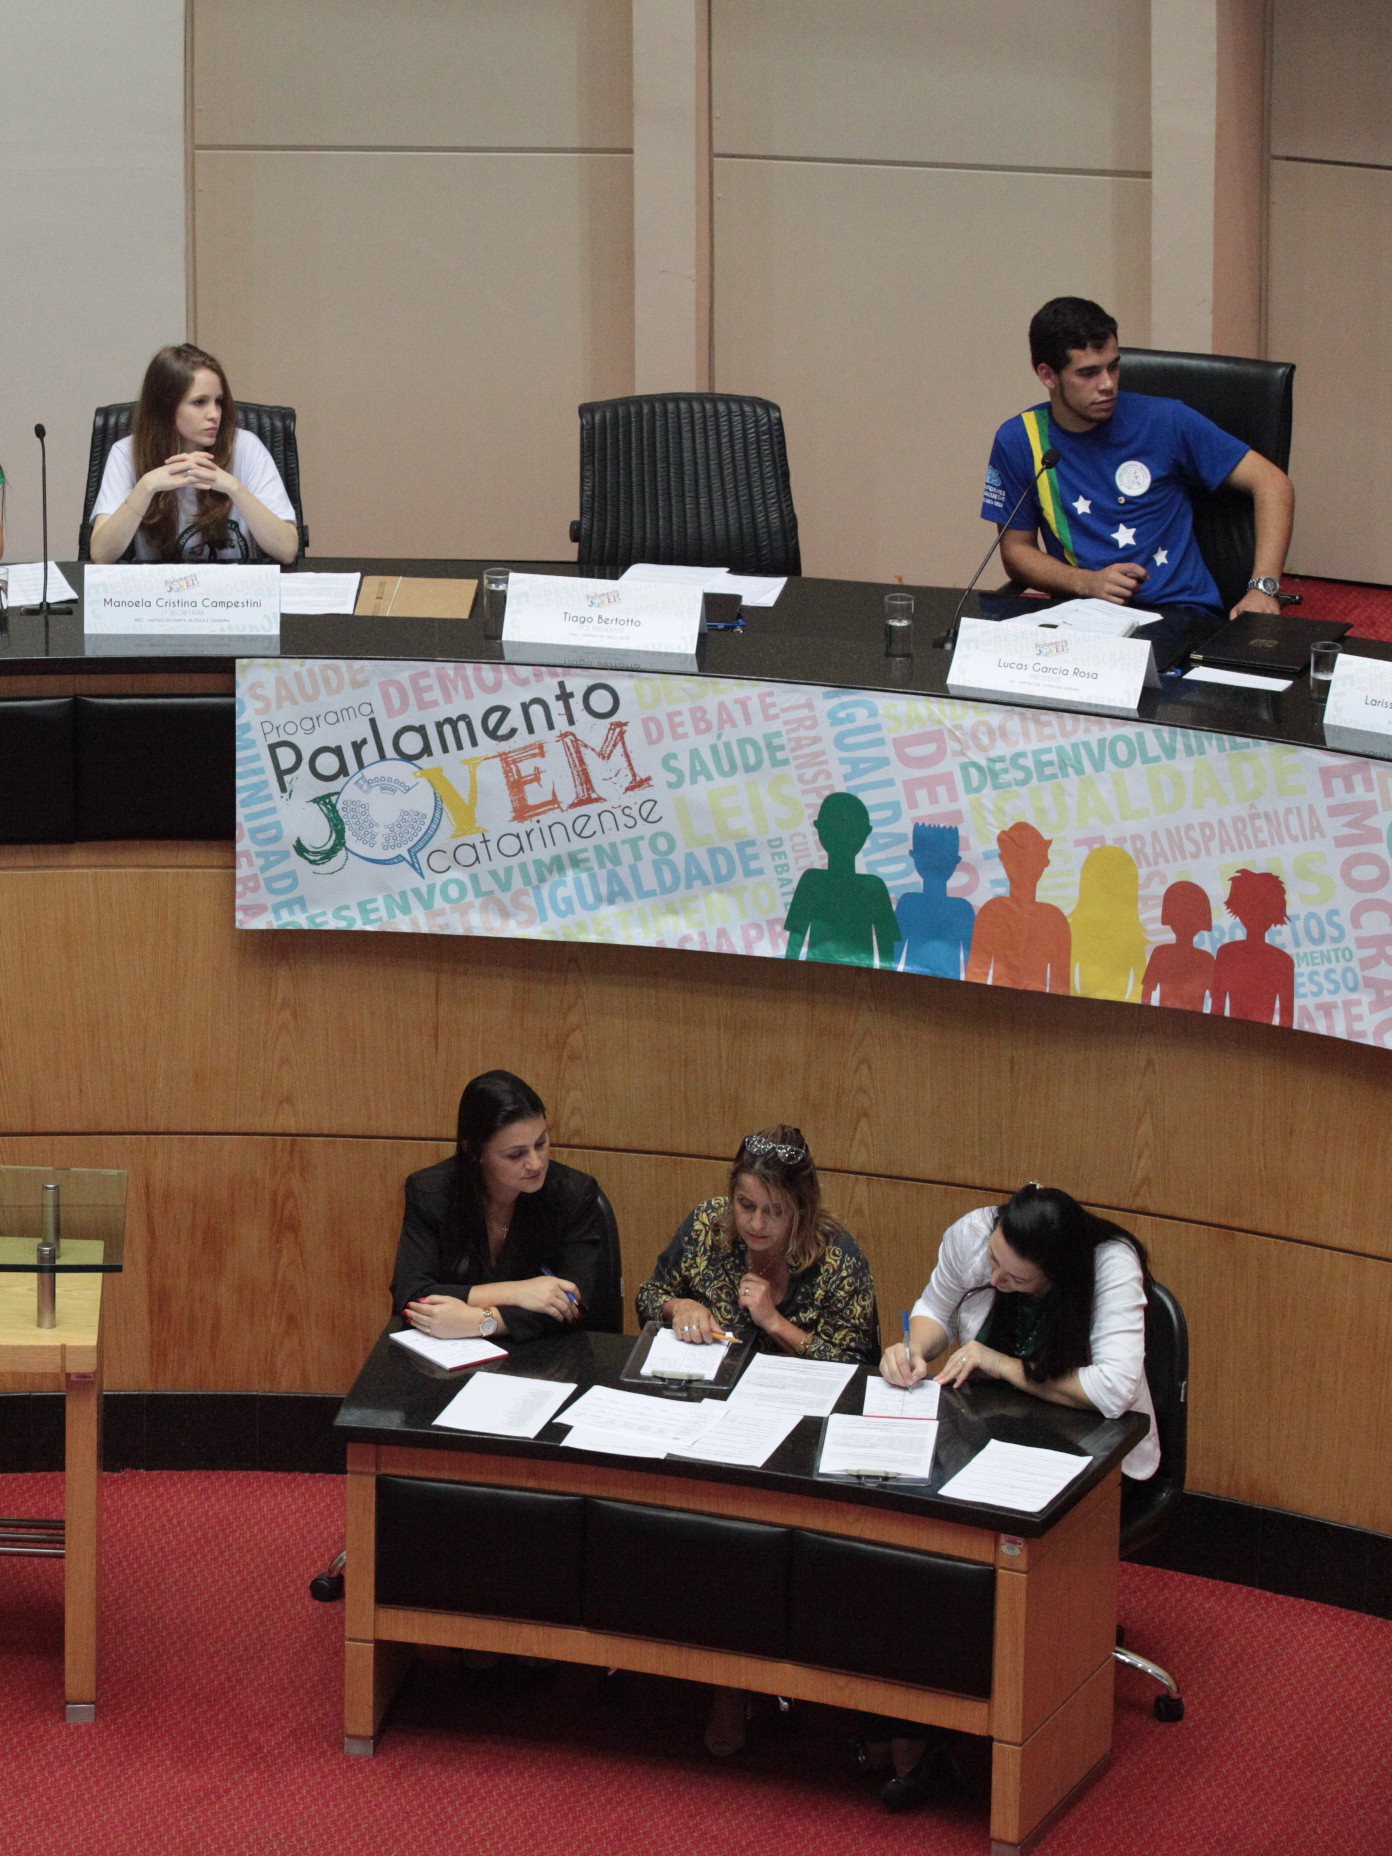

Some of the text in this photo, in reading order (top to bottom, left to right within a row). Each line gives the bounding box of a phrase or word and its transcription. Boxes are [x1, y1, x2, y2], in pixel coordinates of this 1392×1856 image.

[103, 597, 262, 612] Manoela Cristina Campestini
[563, 611, 642, 628] Tiago Bertotto
[997, 657, 1099, 680] Lucas Garcia Rosa
[260, 700, 375, 742] Programa
[266, 680, 621, 794] Parlamento
[640, 689, 780, 747] DEBATE
[661, 731, 791, 790] SAÚDE
[426, 798, 663, 874] catarinense
[672, 773, 805, 851] LEIS
[530, 838, 765, 923] IGUALDADE
